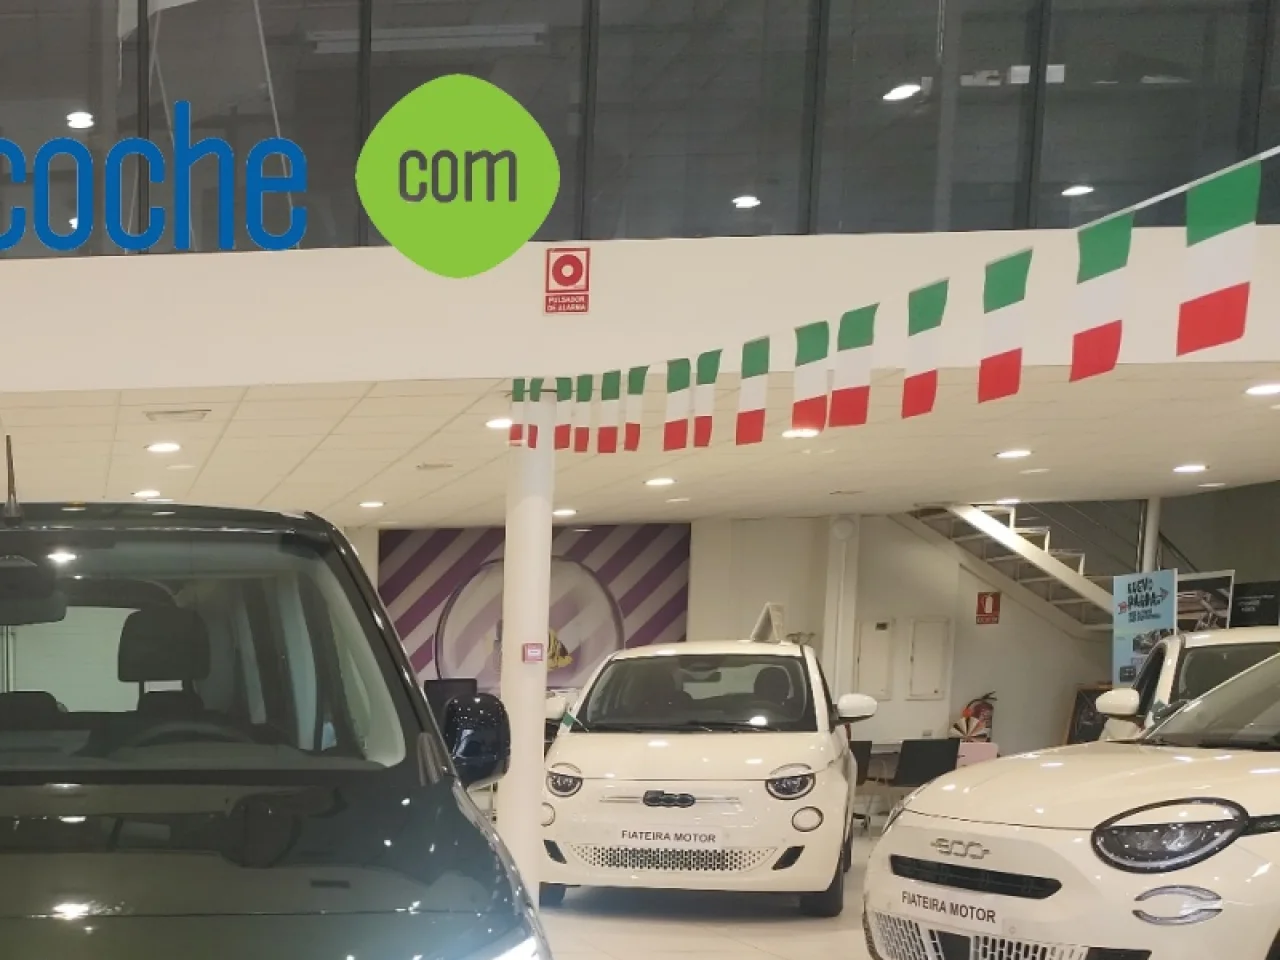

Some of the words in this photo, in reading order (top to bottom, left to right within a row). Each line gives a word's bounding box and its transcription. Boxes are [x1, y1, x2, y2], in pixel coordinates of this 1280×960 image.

[621, 830, 670, 841] FIATEIRA
[673, 833, 716, 843] MOTOR
[902, 891, 947, 914] FIATEIRA
[950, 902, 996, 923] MOTOR
